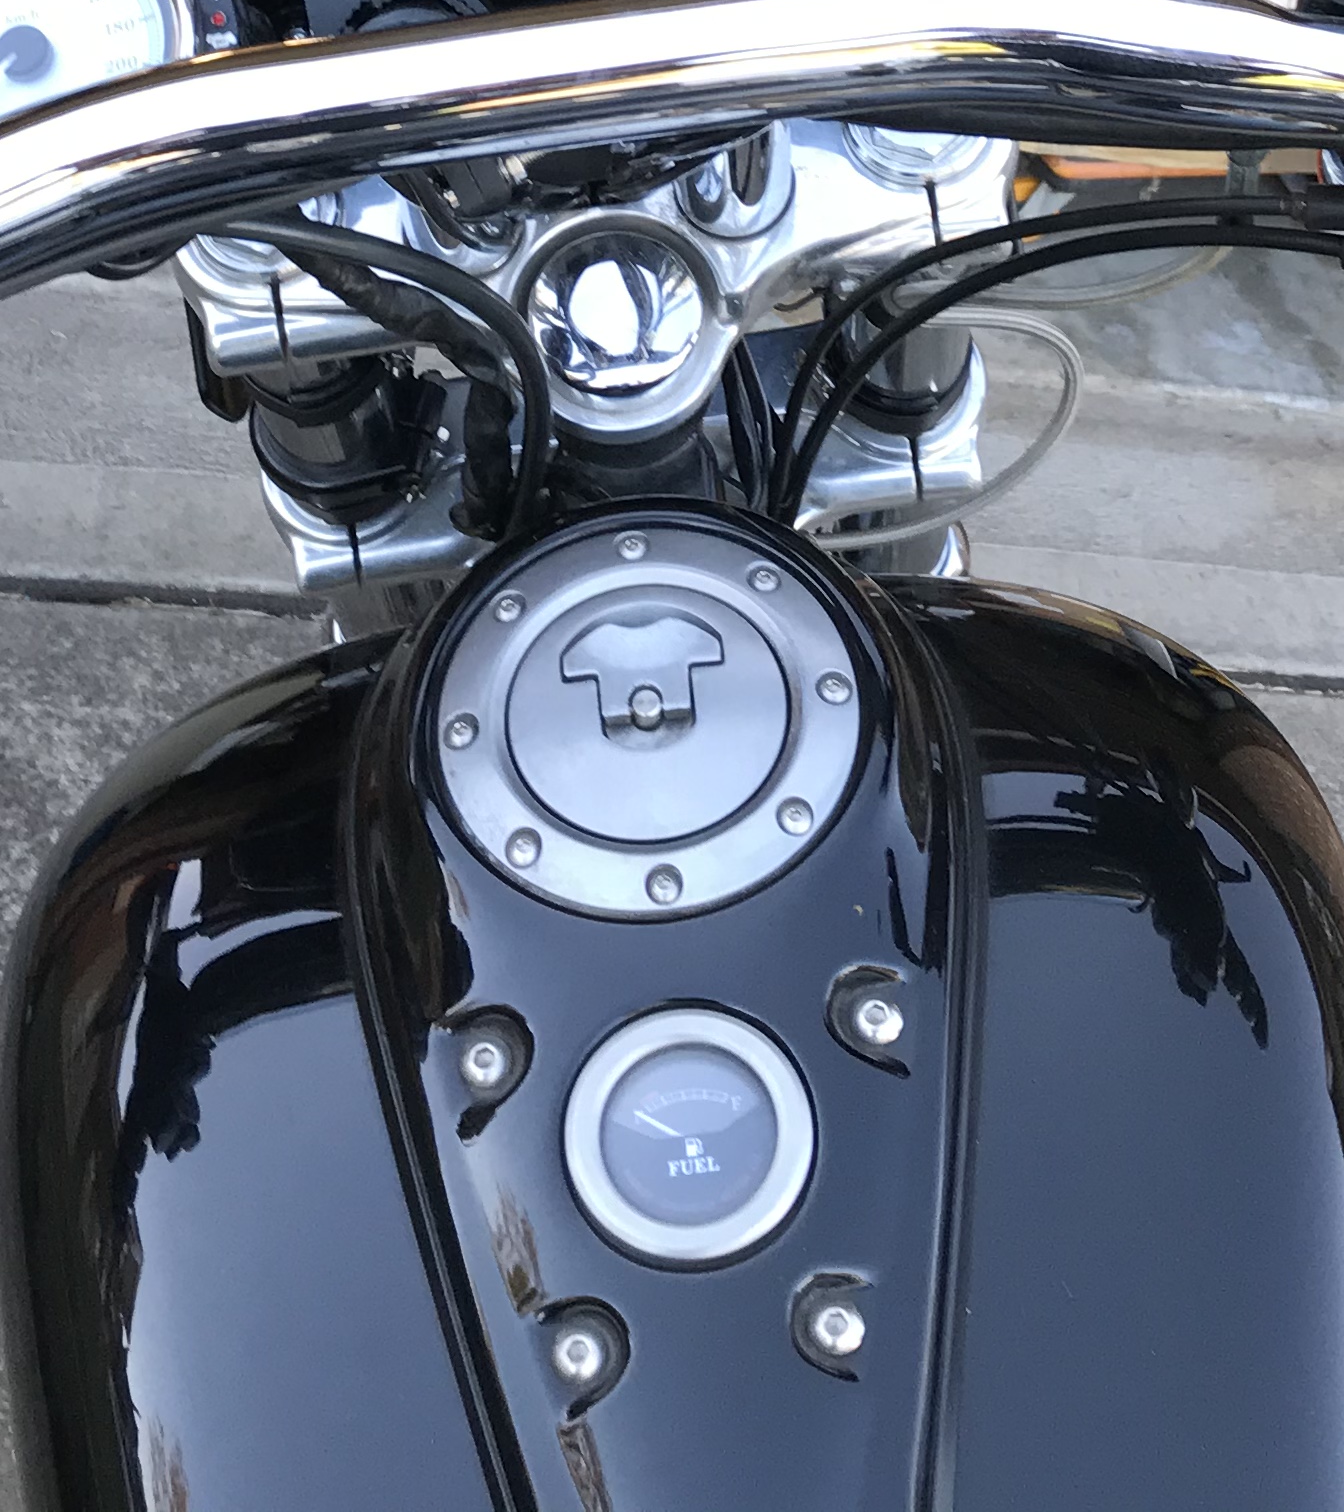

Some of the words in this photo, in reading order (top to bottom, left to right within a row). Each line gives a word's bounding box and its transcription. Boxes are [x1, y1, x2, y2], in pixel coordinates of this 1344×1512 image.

[106, 18, 135, 35] 180
[107, 55, 138, 74] 200
[666, 1155, 721, 1178] FUEL
